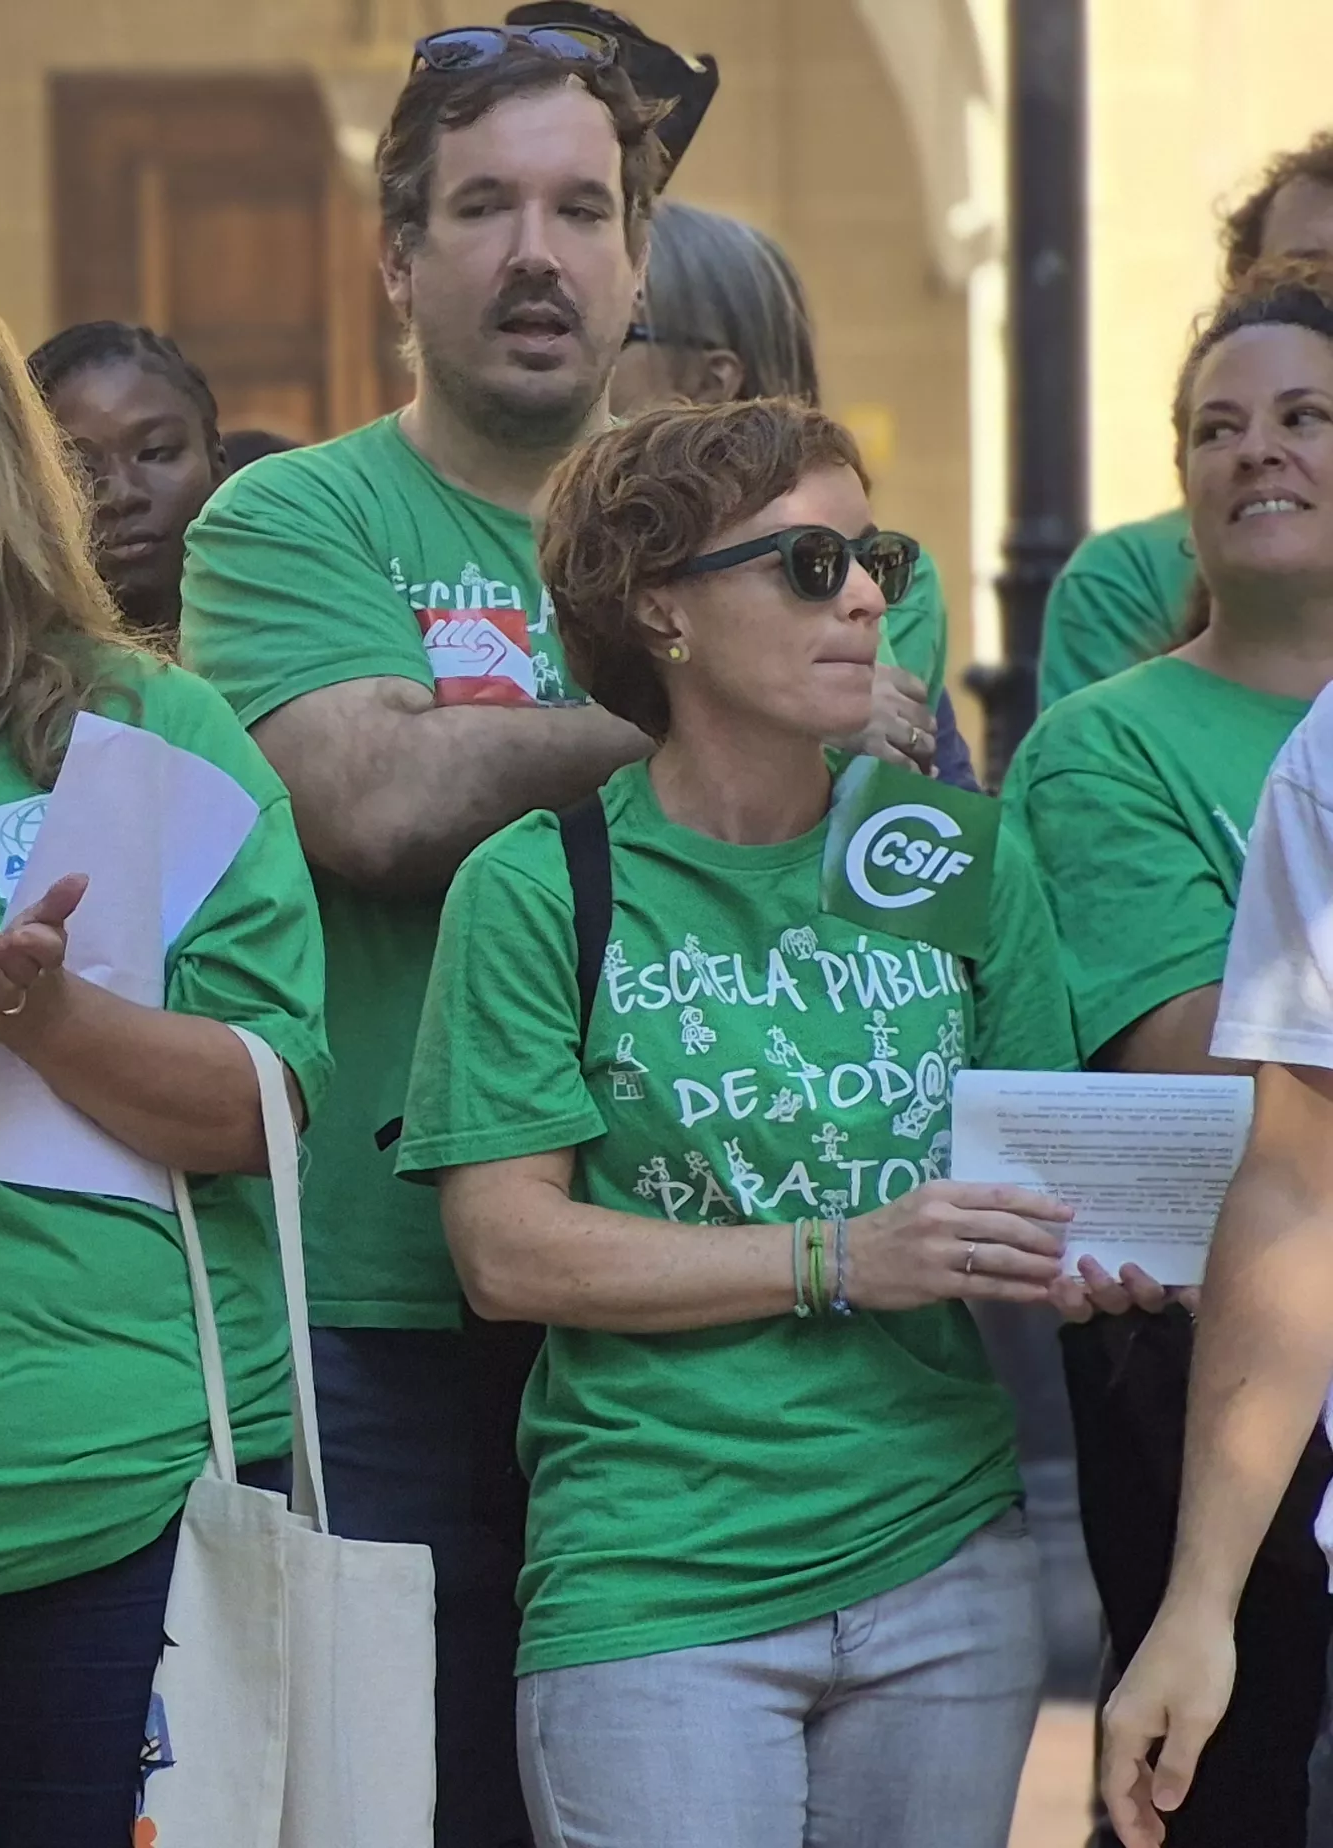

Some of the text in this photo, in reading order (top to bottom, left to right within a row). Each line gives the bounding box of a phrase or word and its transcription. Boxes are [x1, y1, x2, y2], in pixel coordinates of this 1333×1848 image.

[870, 831, 974, 884] CSIF
[608, 948, 808, 1013] ESCUELA
[674, 1068, 758, 1128] DE
[655, 1160, 819, 1223] PARA
